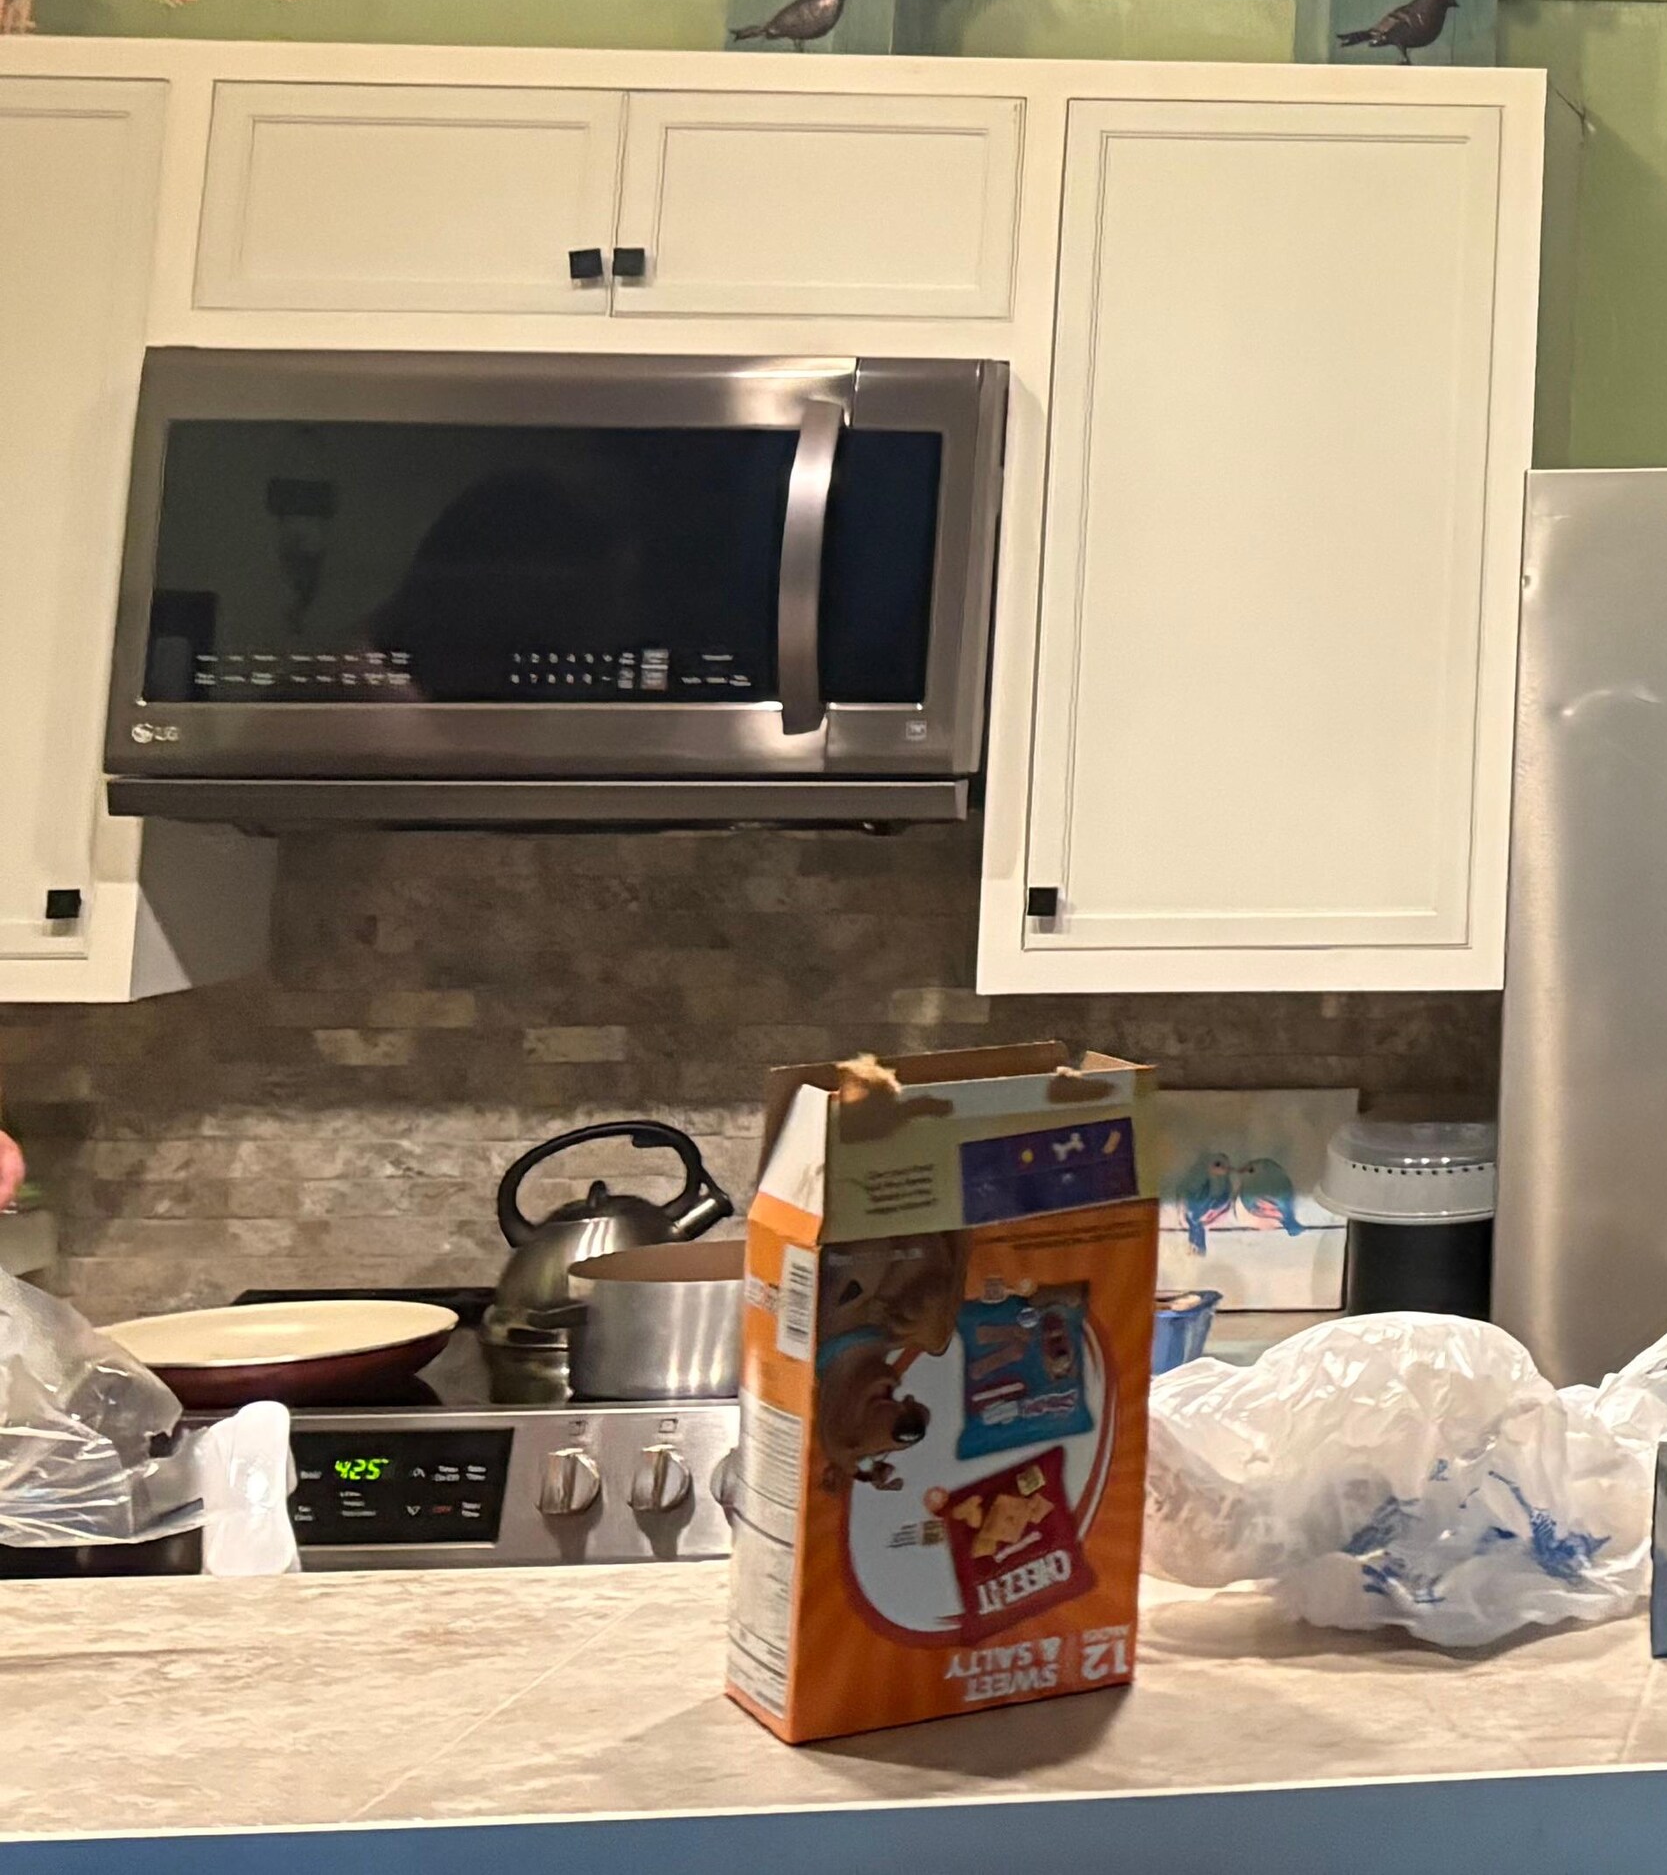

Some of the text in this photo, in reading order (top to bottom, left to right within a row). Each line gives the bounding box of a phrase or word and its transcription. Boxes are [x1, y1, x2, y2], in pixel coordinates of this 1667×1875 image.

[943, 1640, 1034, 1680] SALTY
[1081, 1639, 1130, 1681] 12
[964, 1662, 1058, 1702] SWEET
